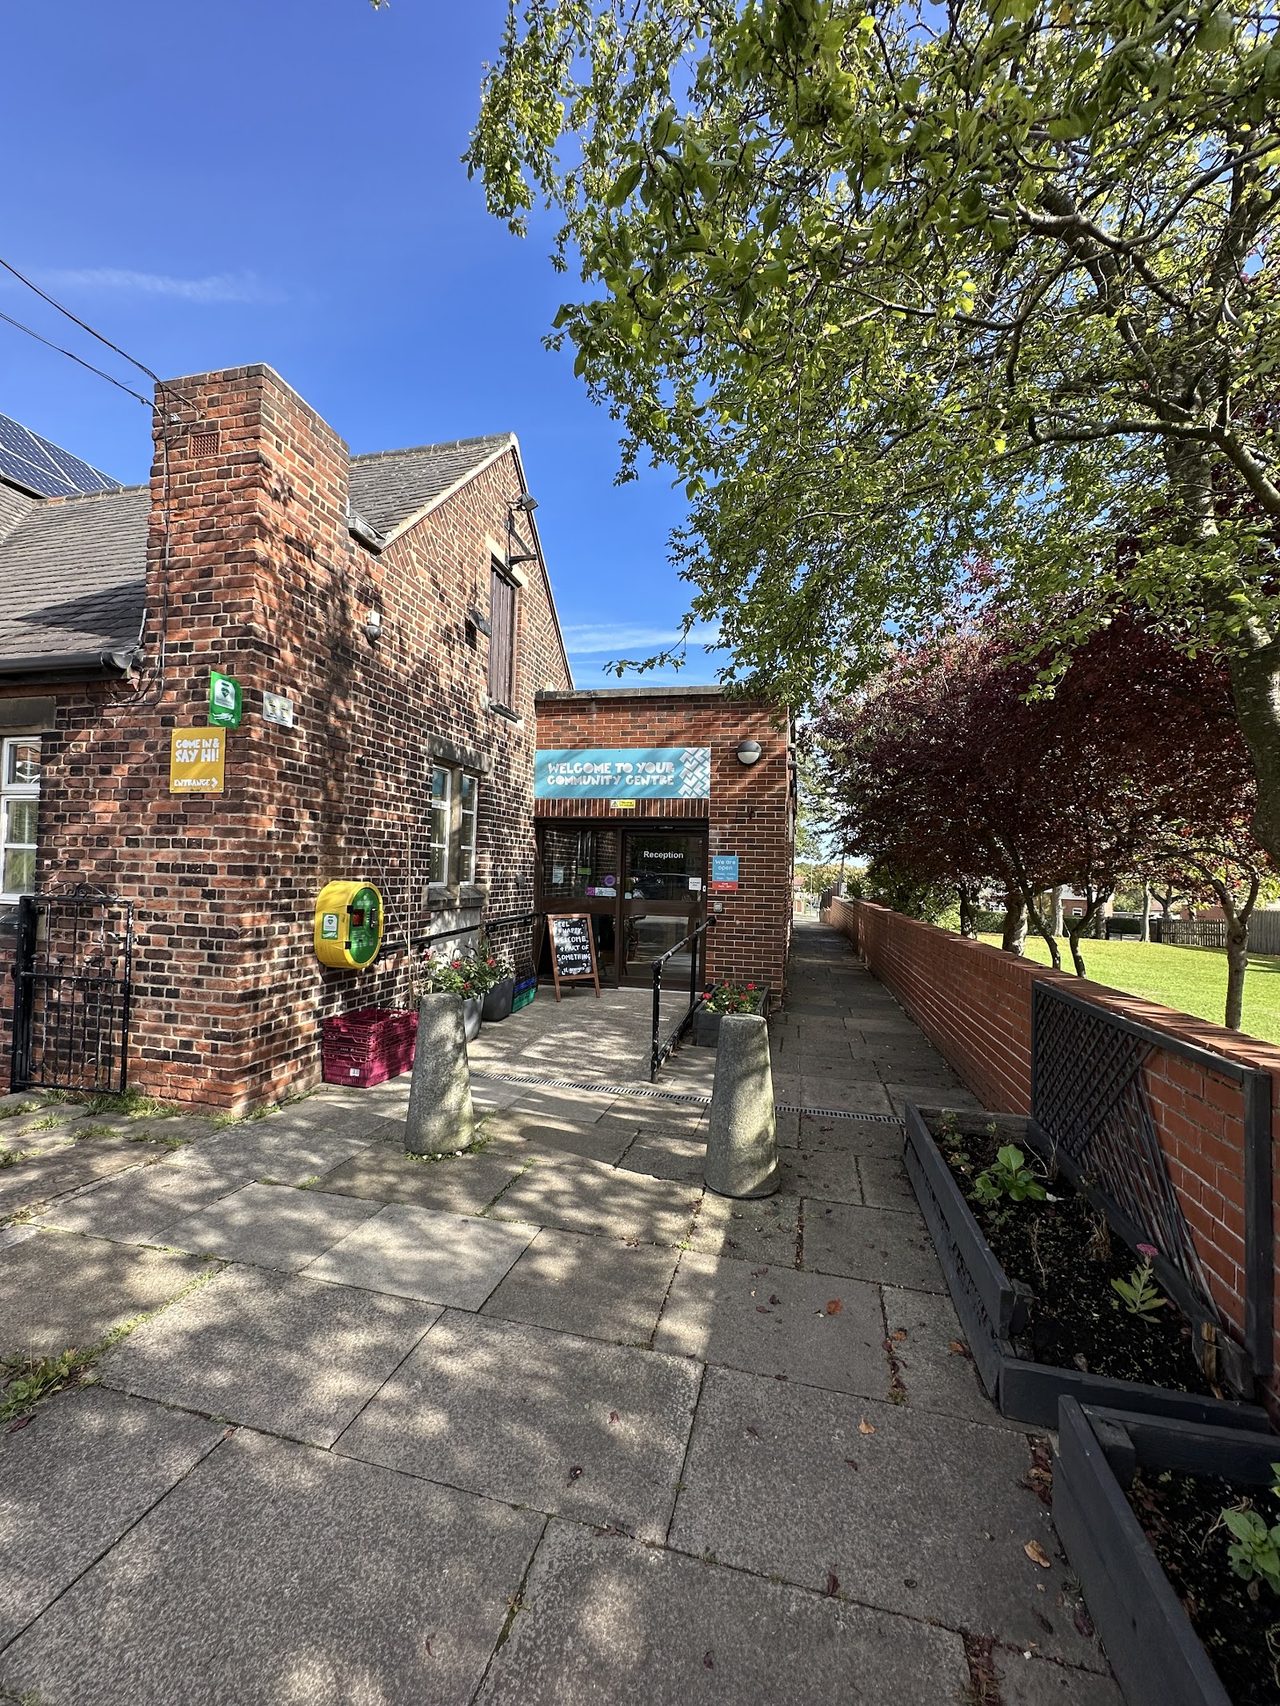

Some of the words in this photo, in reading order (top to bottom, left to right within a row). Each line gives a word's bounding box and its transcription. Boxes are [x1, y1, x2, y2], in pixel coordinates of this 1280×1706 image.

[176, 739, 200, 748] COME
[202, 739, 211, 748] IN
[175, 749, 198, 762] SAY
[201, 748, 219, 762] HI!
[547, 762, 612, 774] WELCOME
[614, 762, 634, 774] TO
[635, 762, 675, 774] YOUR
[173, 778, 211, 787] ENTRANCE
[546, 775, 622, 786] COMMUNITY
[625, 775, 675, 786] CENTRE
[643, 850, 684, 860] Reception
